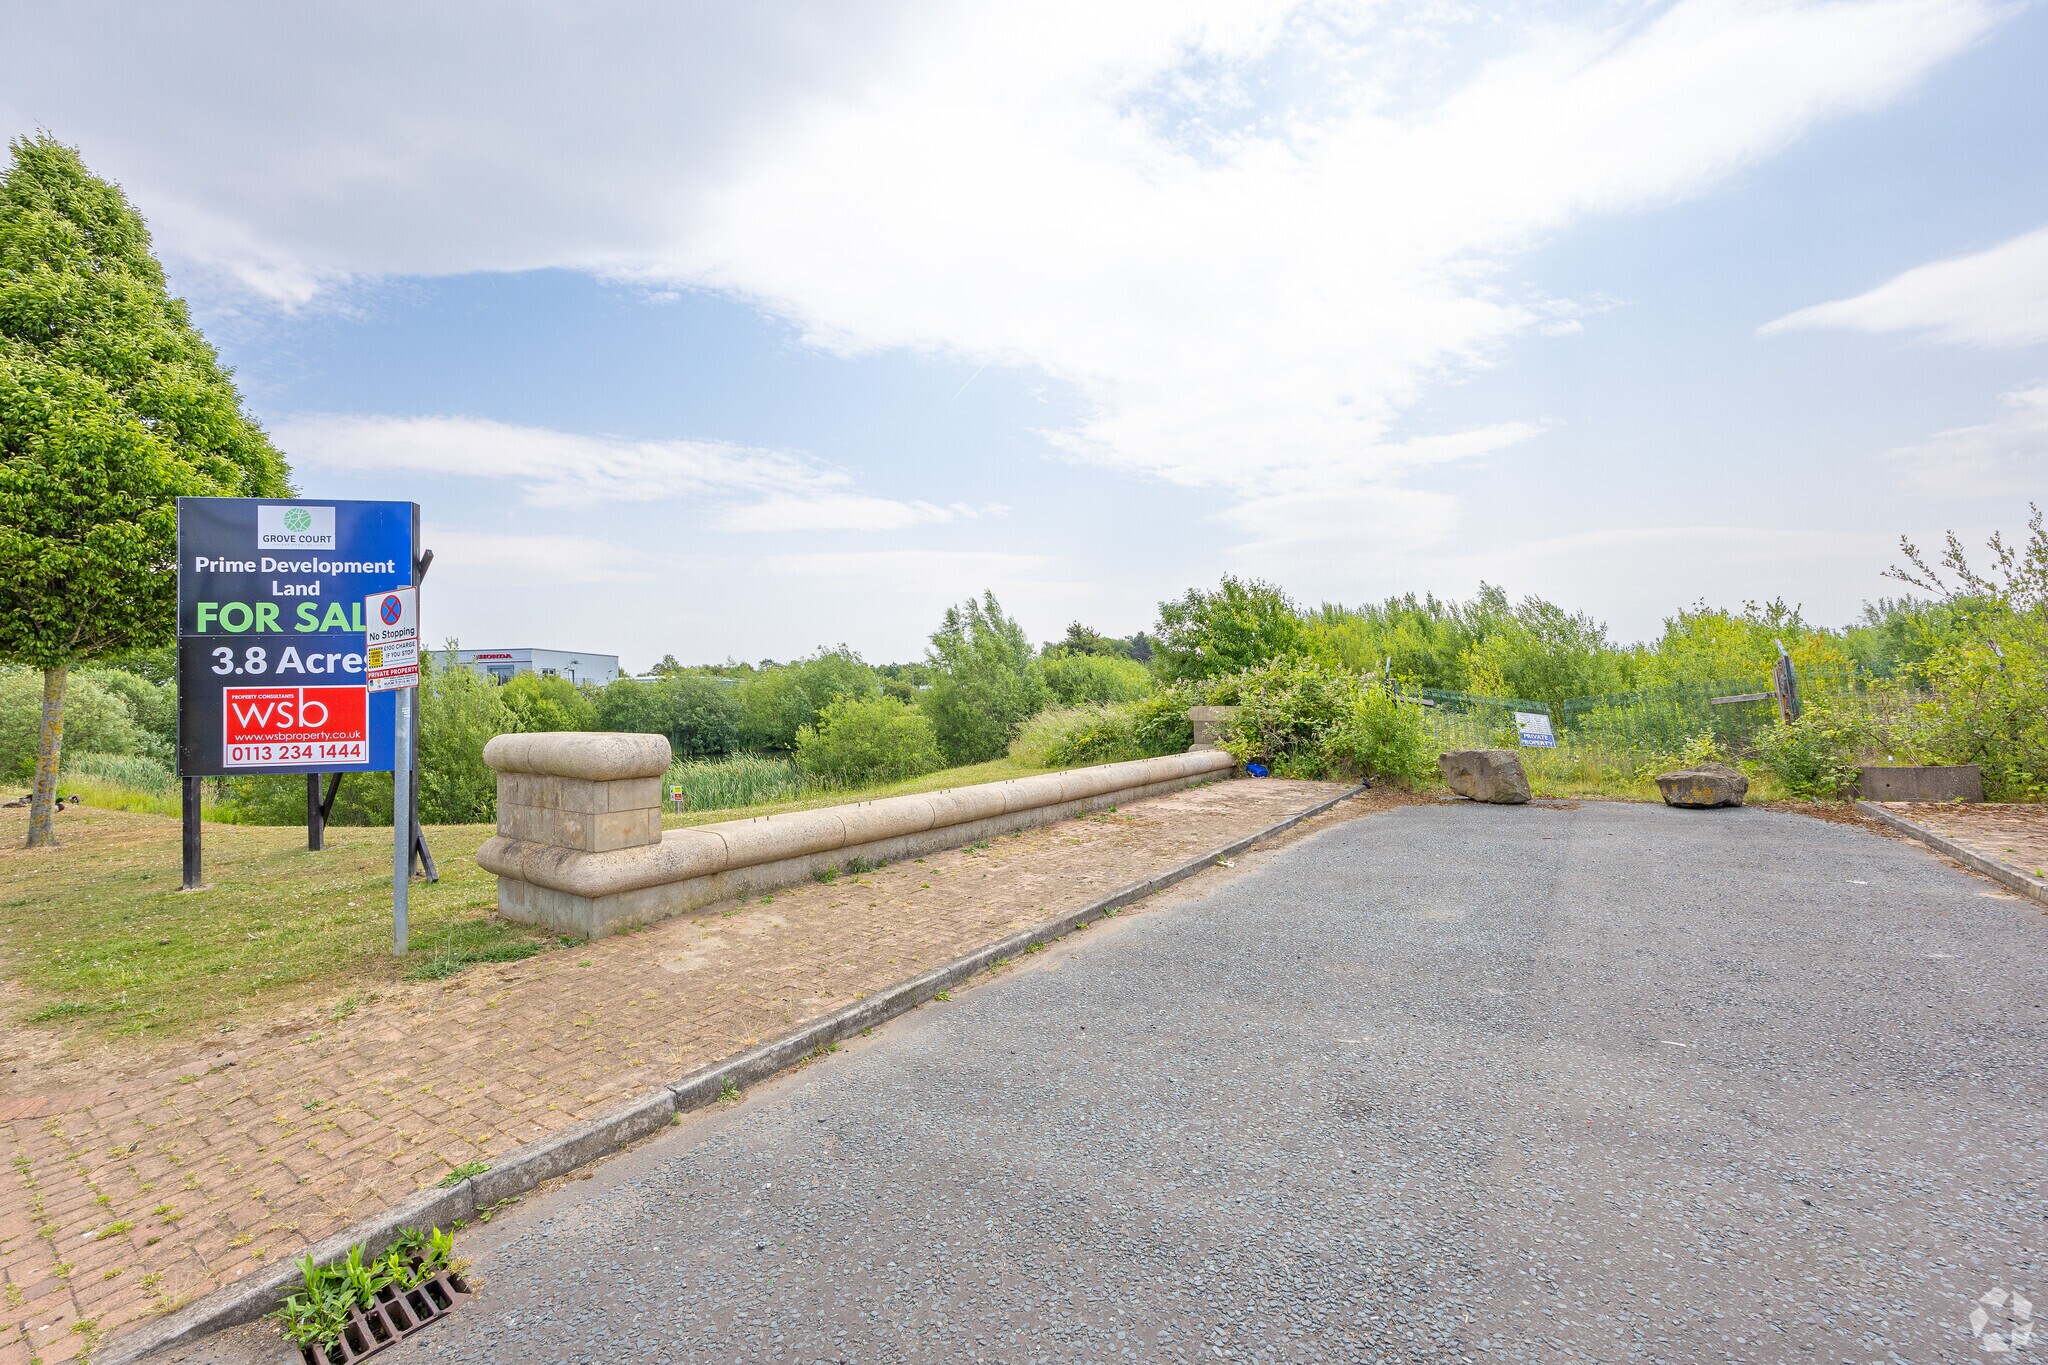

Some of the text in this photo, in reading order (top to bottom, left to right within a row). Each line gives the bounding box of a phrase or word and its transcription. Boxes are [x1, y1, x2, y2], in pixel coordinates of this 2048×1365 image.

[262, 534, 332, 543] GROVE COURT
[195, 556, 395, 576] Prime Development
[272, 580, 320, 597] Land
[197, 602, 366, 633] FOR SAL
[369, 627, 415, 641] No Stopping
[396, 641, 415, 649] CHARGE
[211, 647, 267, 675] 3.8
[391, 666, 417, 675] PROPERTY
[232, 688, 328, 729] wsb
[234, 730, 361, 742] www.wsbproperty.co.uk
[232, 743, 361, 761] 0113 234 1444
